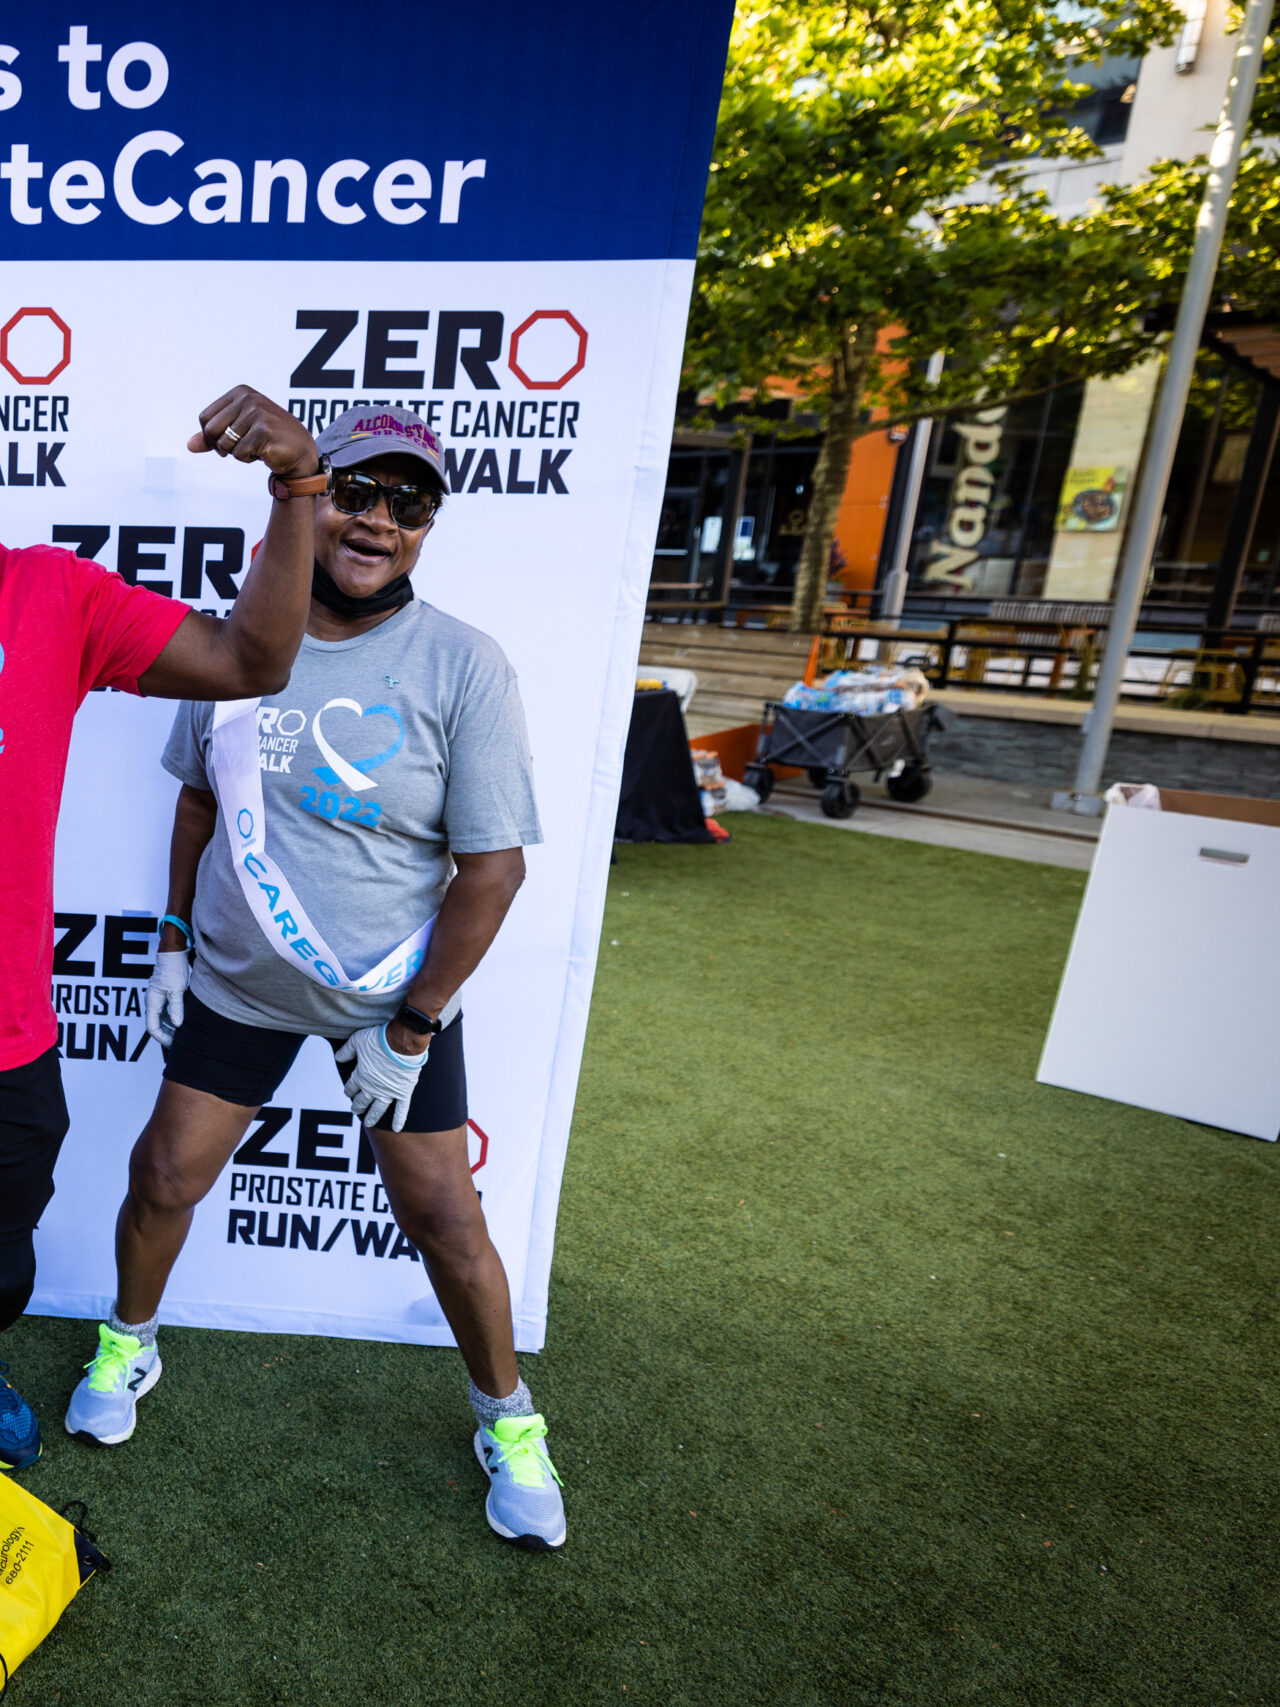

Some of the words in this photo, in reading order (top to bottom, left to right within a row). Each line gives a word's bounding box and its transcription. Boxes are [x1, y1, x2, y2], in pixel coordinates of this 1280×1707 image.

[58, 25, 169, 110] to
[290, 310, 588, 390] ZERO
[450, 401, 580, 438] CANCER
[443, 448, 573, 495] WALK
[52, 525, 263, 600] ZER
[255, 706, 307, 736] RO
[259, 753, 294, 774] ALK
[299, 785, 382, 828] 2022
[53, 912, 158, 979] ZE
[230, 1172, 366, 1211] PROSTATE
[227, 1208, 420, 1262] RUN/WA
